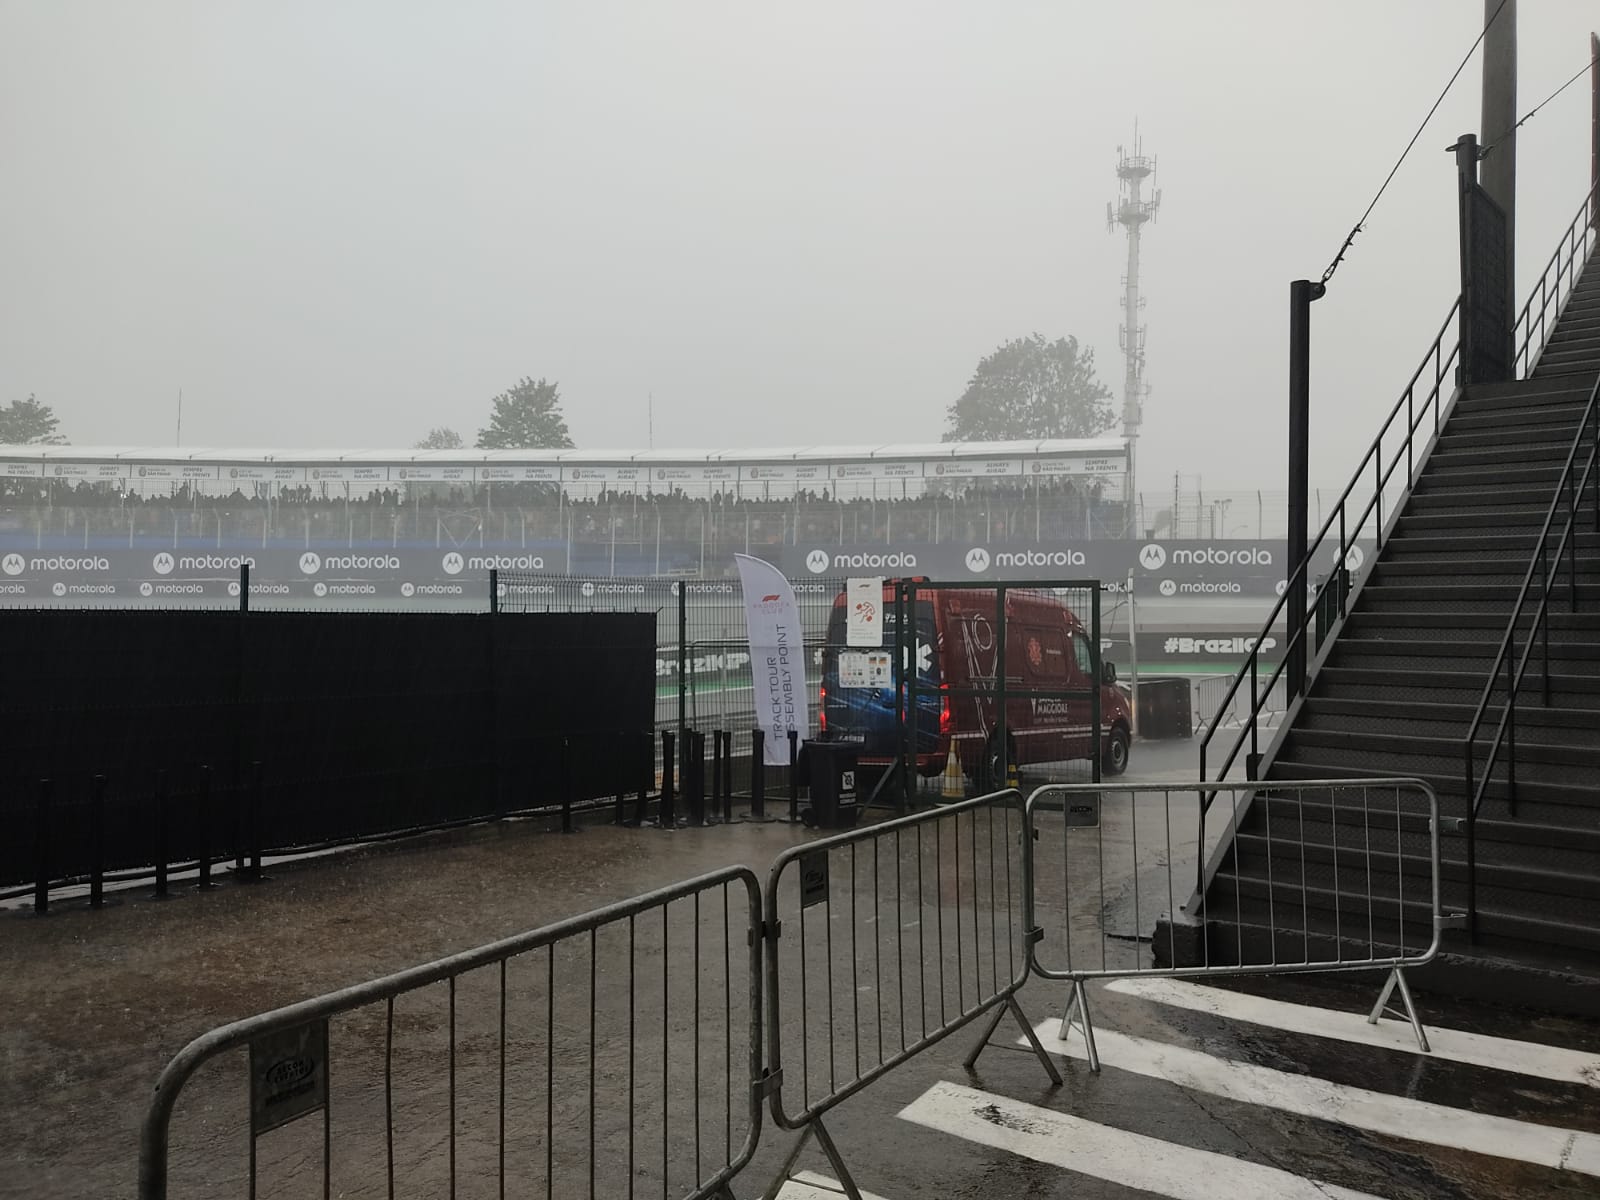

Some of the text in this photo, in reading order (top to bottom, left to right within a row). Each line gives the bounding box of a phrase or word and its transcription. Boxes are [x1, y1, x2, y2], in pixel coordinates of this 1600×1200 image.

[30, 555, 110, 570] motorola
[179, 554, 256, 569] motorola
[325, 554, 400, 569] motorola
[468, 554, 544, 569] motorola
[834, 552, 917, 567] motorola
[995, 549, 1086, 567] motorola
[1172, 547, 1272, 565] motorola
[69, 583, 116, 594] motorola
[155, 583, 204, 593] motorola
[329, 584, 376, 594] motorola
[416, 584, 463, 594] motorola
[509, 584, 555, 594] motorola
[597, 583, 645, 593] motorola
[686, 583, 733, 593] motorola
[1179, 581, 1241, 593] motorola
[1163, 637, 1277, 654] #BrazilGP
[776, 624, 796, 732] SSEMBLY POINT
[767, 656, 784, 742] TRACK TOUR
